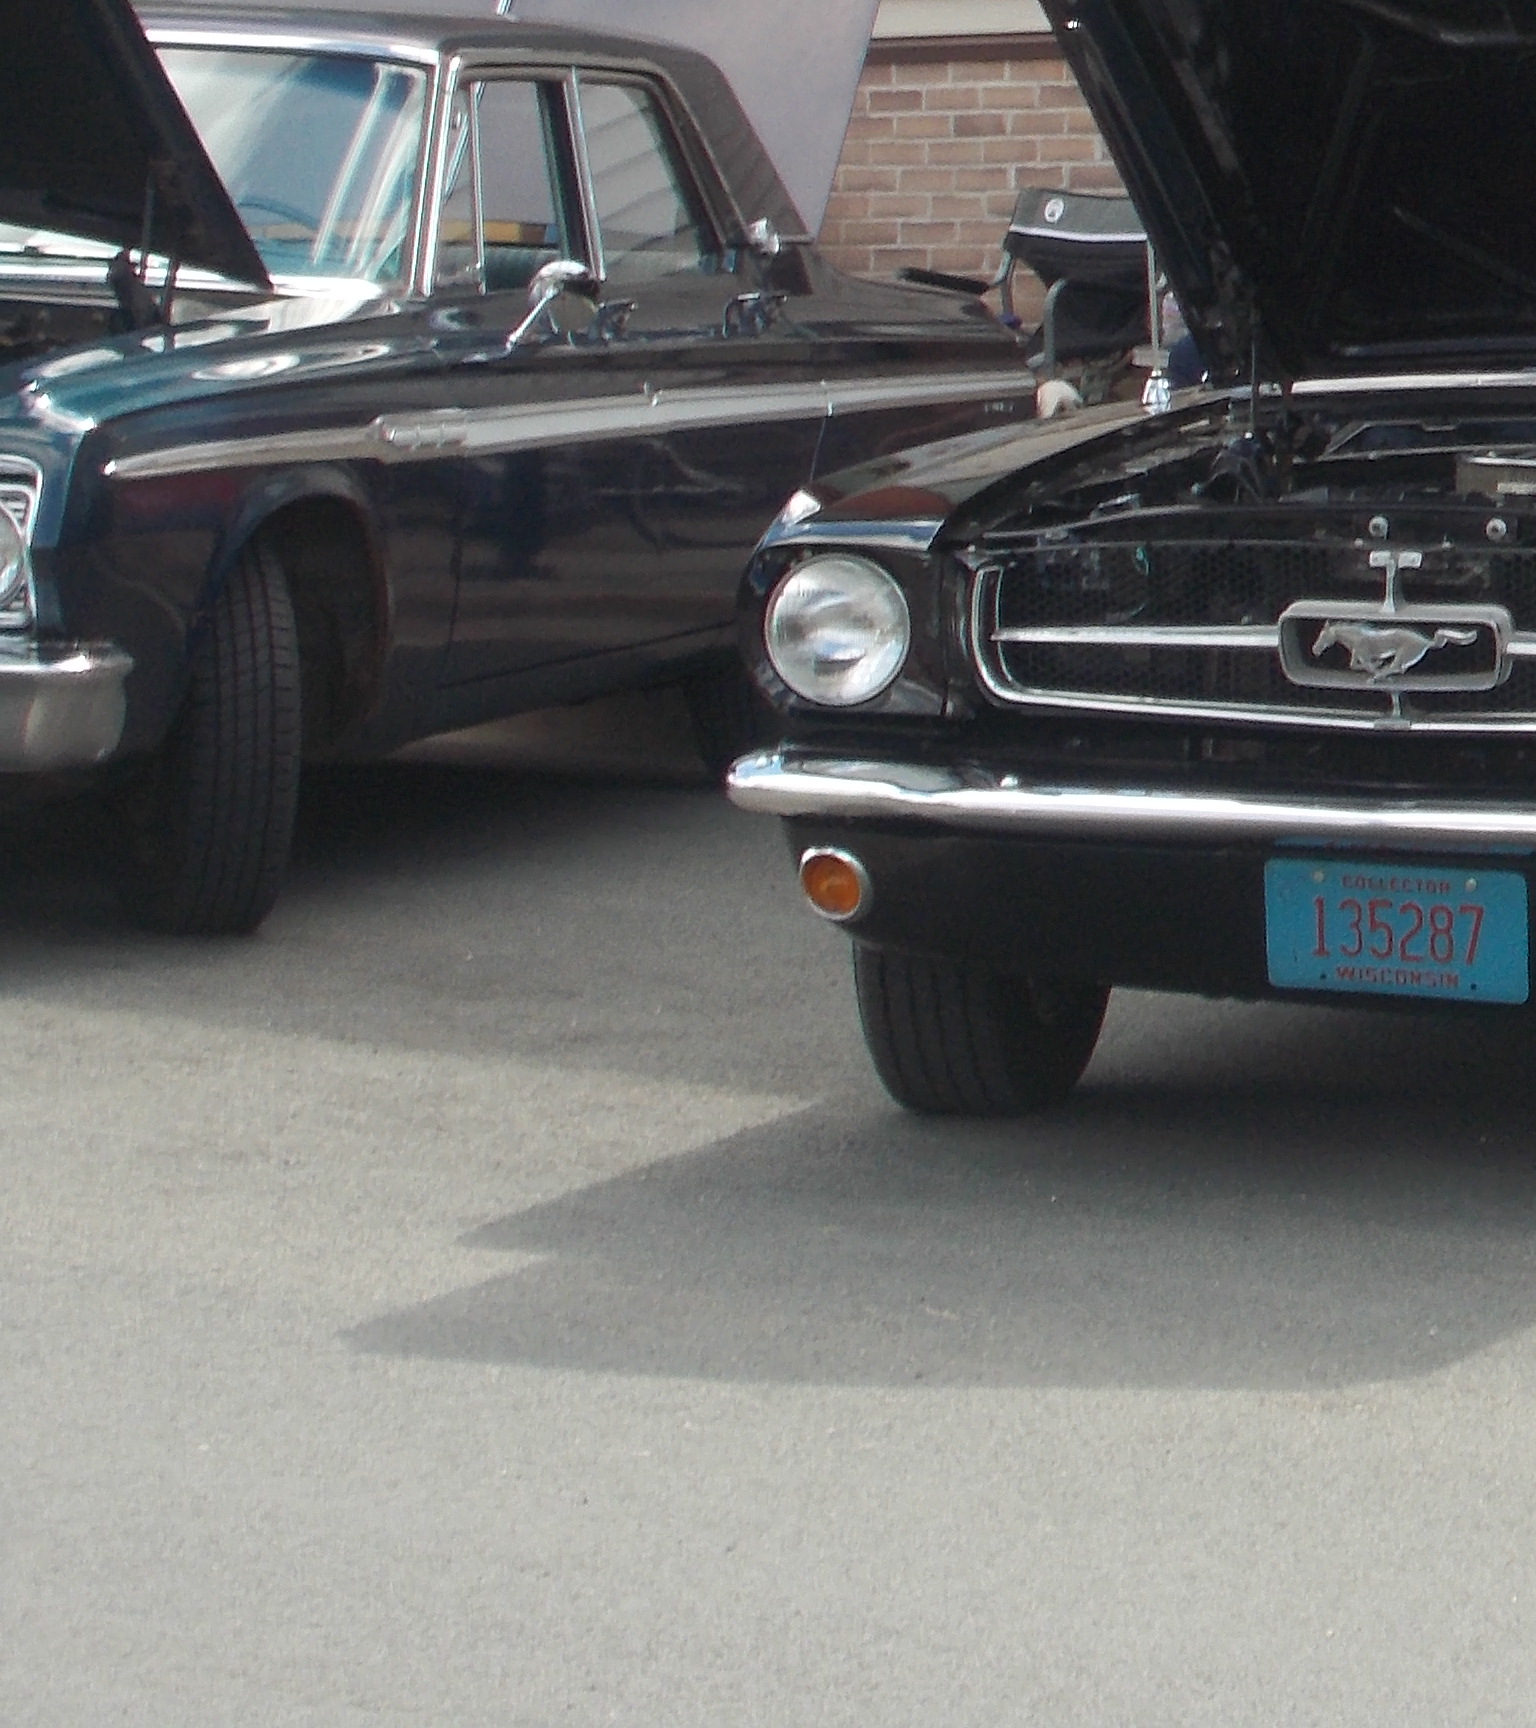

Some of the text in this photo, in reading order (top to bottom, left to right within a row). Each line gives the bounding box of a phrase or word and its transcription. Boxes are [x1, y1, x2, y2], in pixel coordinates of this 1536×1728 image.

[1341, 874, 1450, 895] COLLECTOR
[1313, 895, 1485, 965] 135287
[1336, 965, 1460, 988] WISCONSIN
